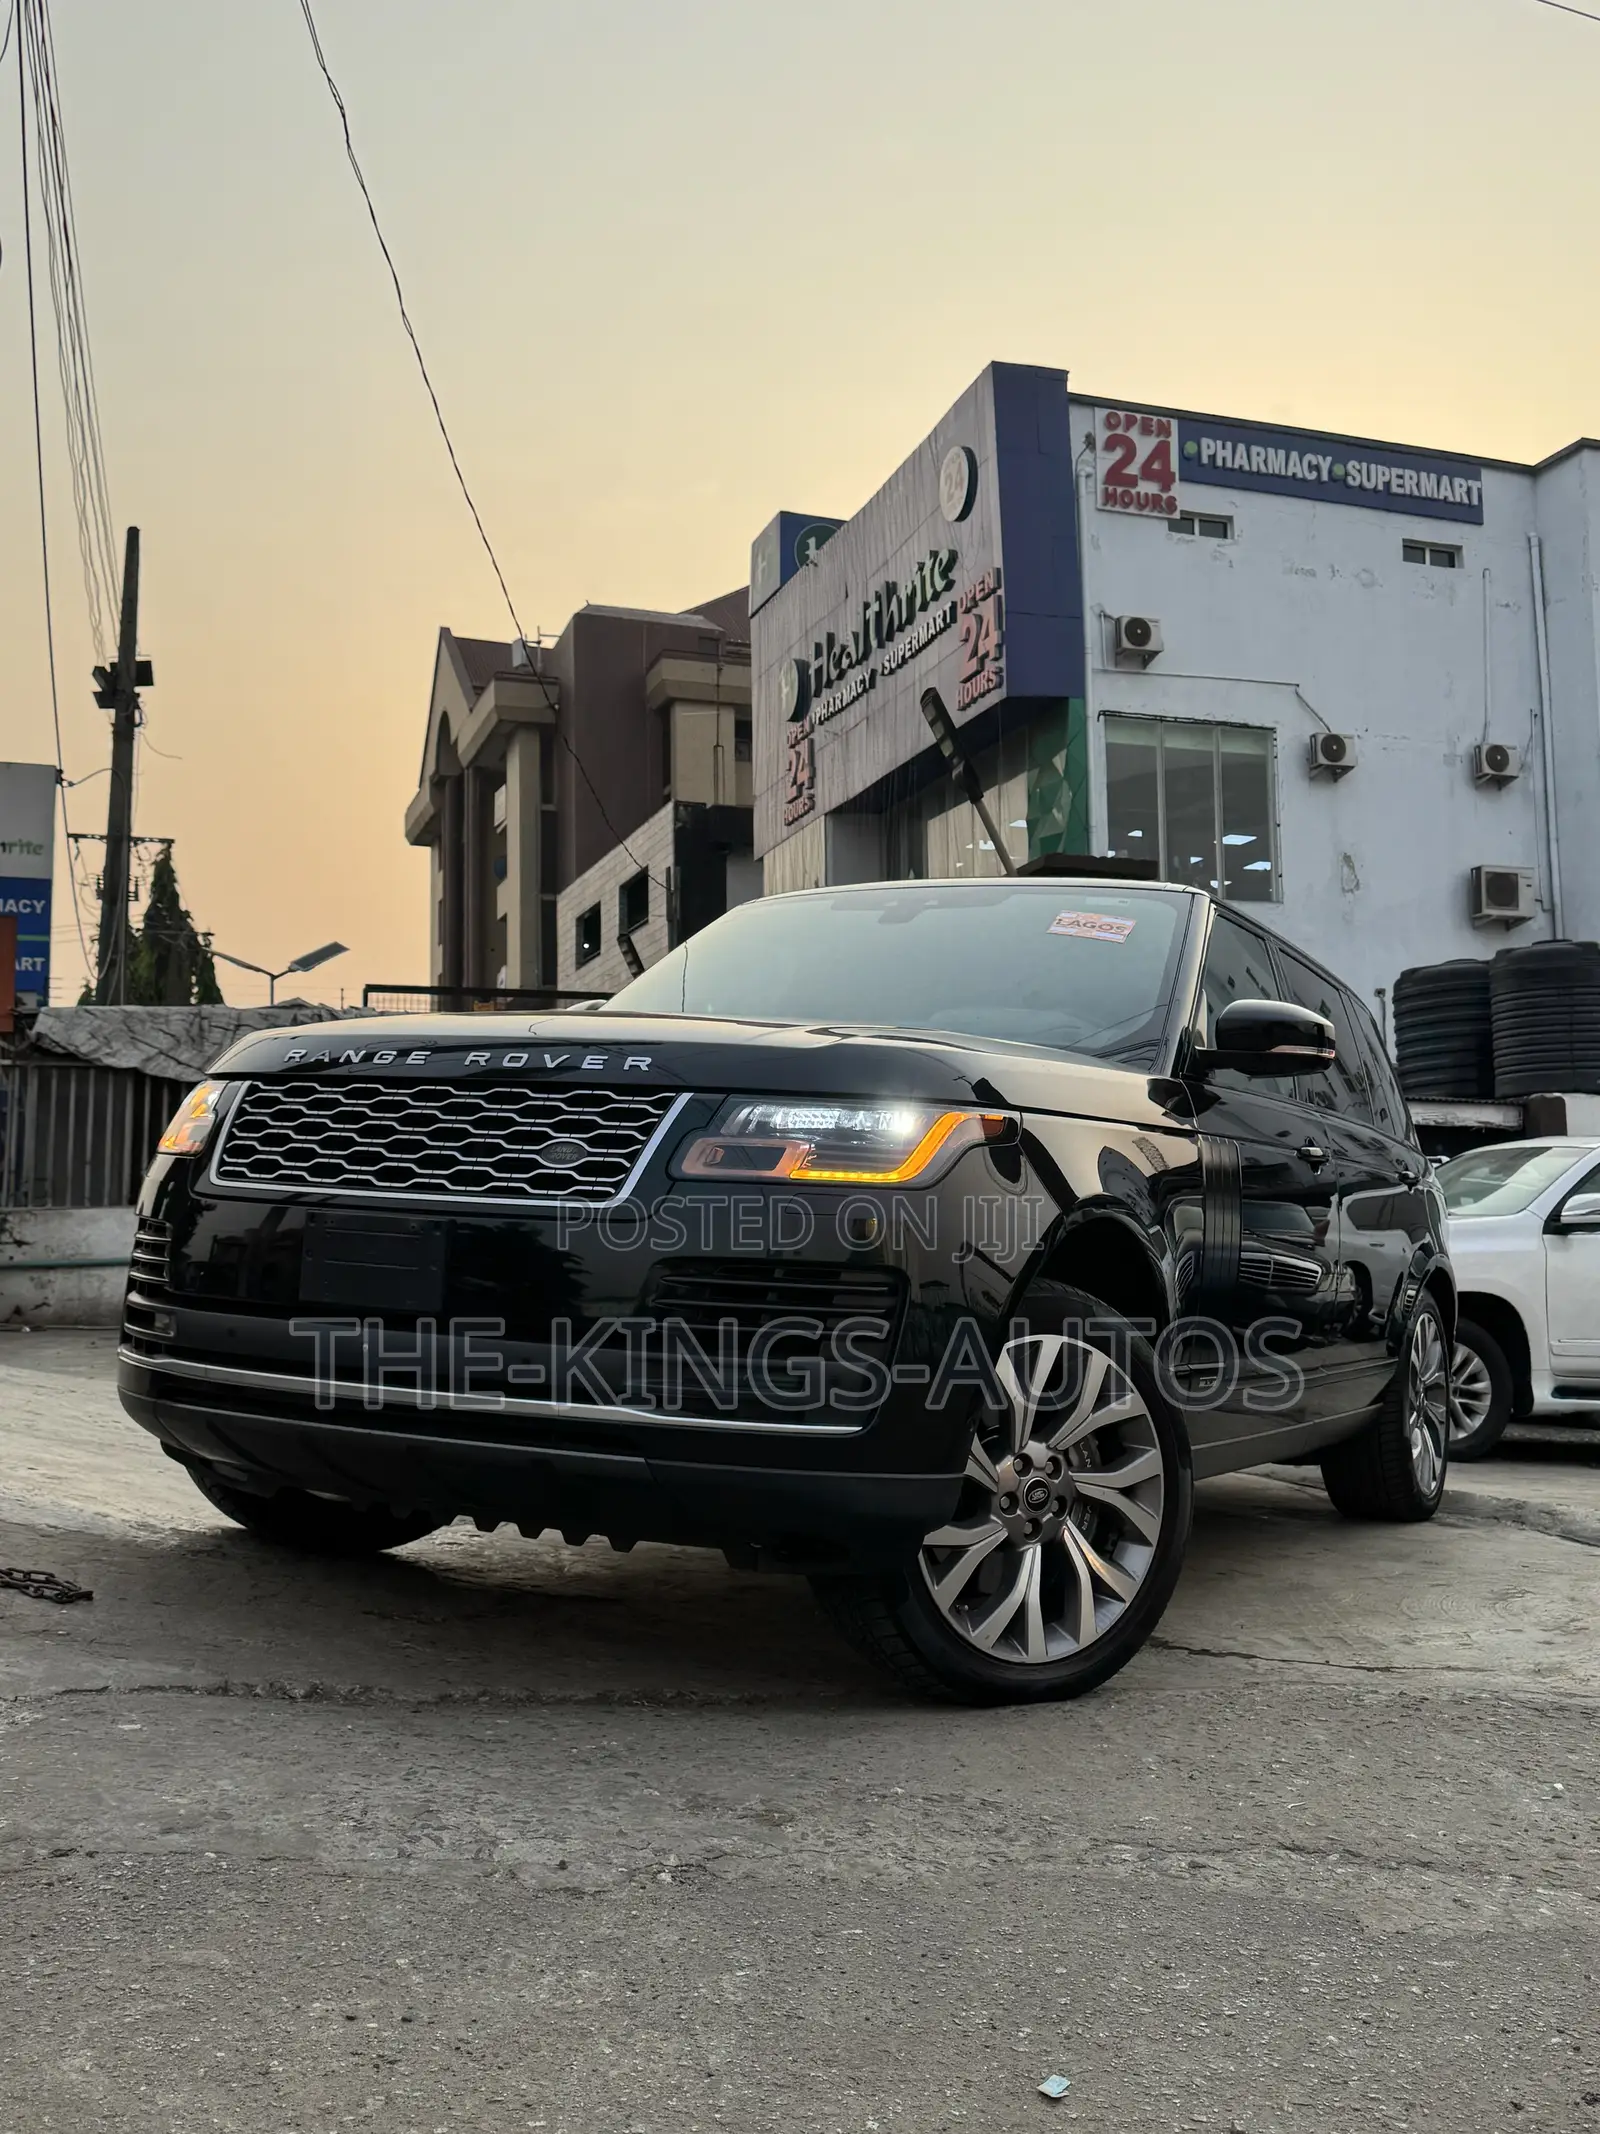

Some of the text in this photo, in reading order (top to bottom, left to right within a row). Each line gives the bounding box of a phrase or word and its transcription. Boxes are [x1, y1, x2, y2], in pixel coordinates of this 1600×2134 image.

[1104, 411, 1172, 439] OPEN
[1102, 433, 1176, 493] 24
[1200, 437, 1482, 507] PHARMACY SUPERMART
[1102, 486, 1178, 515] HOURS
[960, 567, 999, 613] OPEN
[808, 548, 958, 697] Healthrite
[960, 595, 1003, 683] 24
[815, 601, 957, 725] PHARMACY SUPERMART
[957, 666, 1004, 711] HOURS
[787, 714, 815, 749] OPEN
[785, 738, 816, 804] 24
[784, 793, 815, 826] HOURS
[1055, 917, 1127, 933] LAGOS
[284, 1049, 652, 1071] RANGE ROVER
